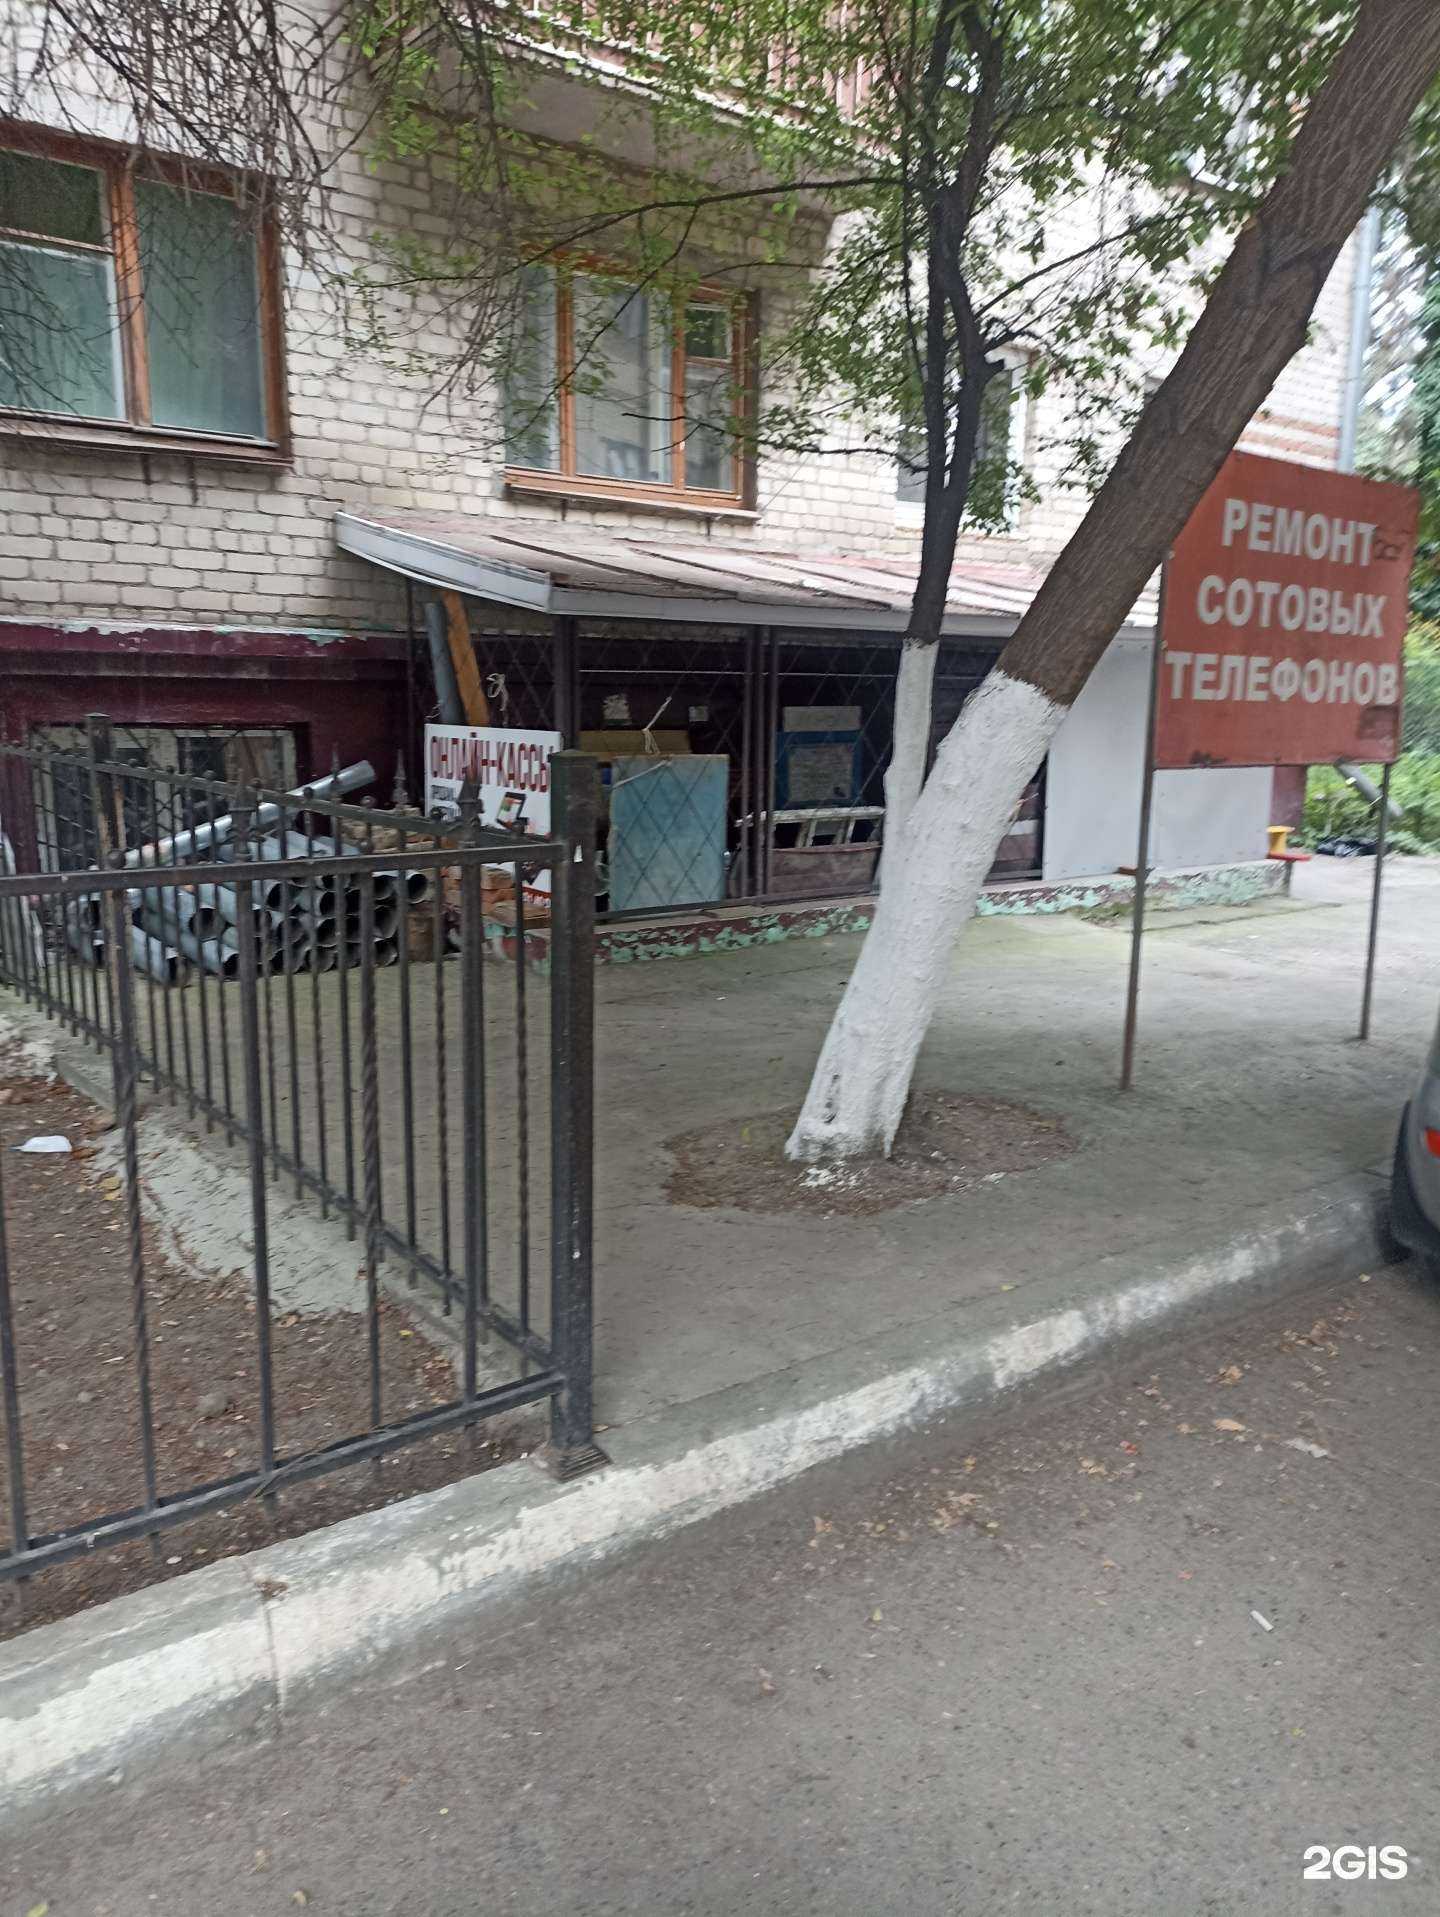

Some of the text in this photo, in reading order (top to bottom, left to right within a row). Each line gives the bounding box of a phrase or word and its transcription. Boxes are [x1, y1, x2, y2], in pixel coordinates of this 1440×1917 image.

[1221, 498, 1378, 566] РЕМОНТ
[1197, 574, 1388, 638] СОТОВЫХ
[1165, 650, 1398, 705] ТЕЛЕФОНОВ
